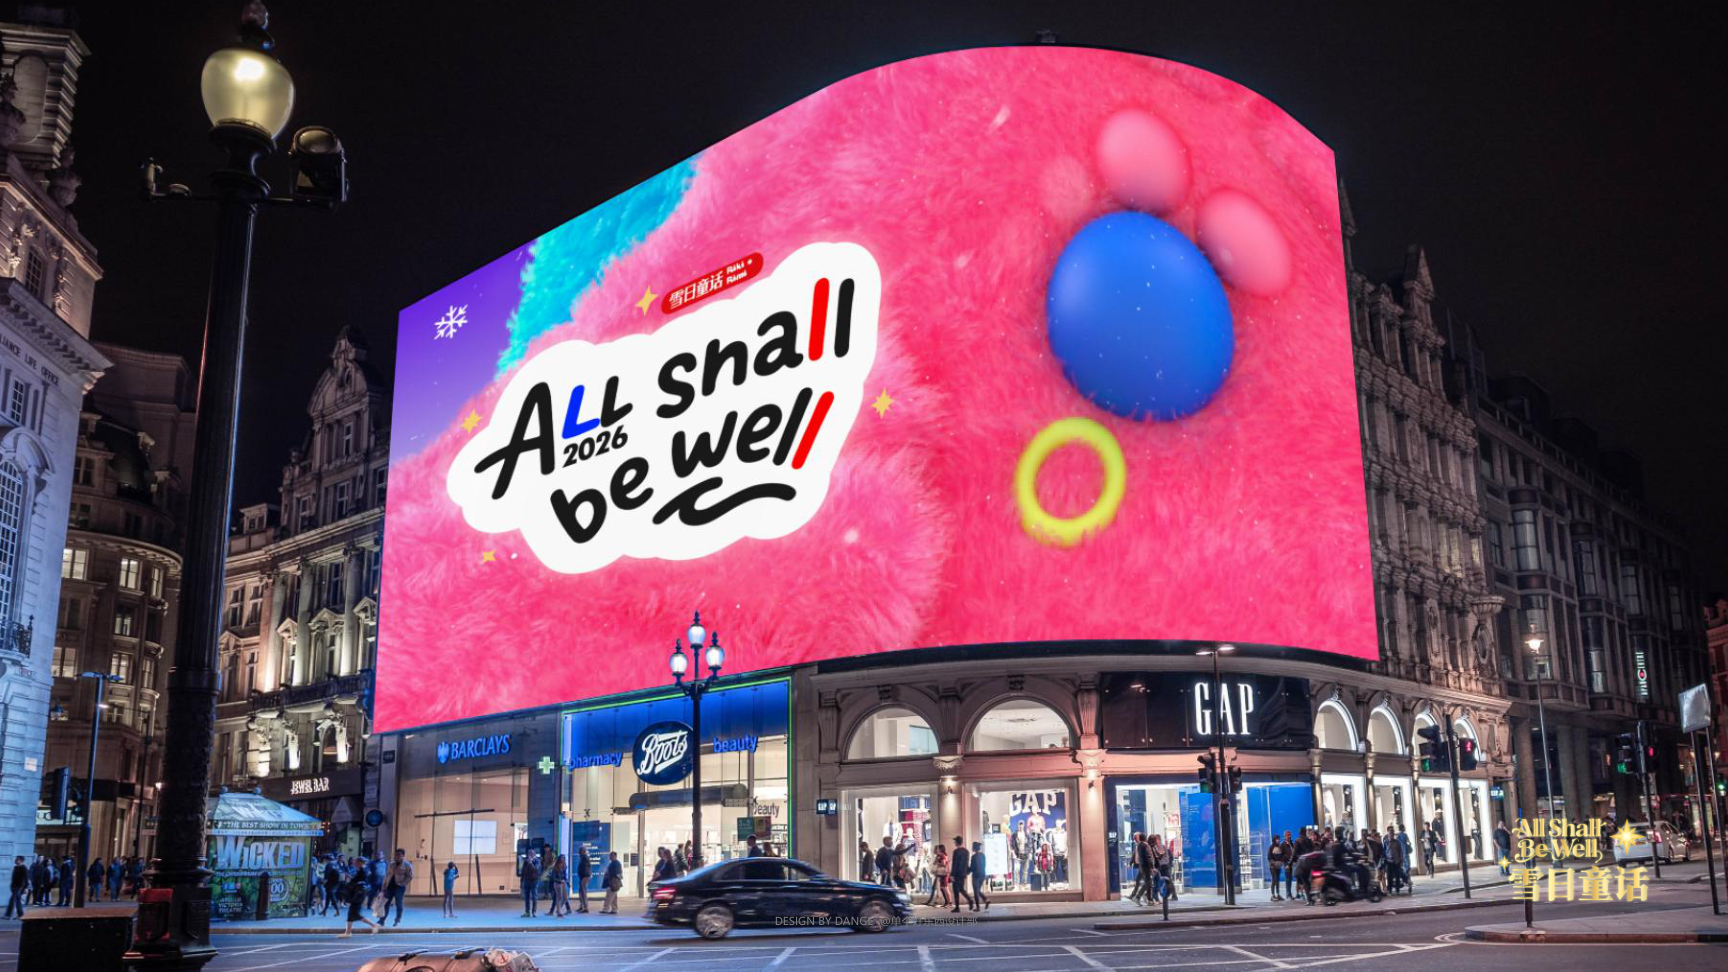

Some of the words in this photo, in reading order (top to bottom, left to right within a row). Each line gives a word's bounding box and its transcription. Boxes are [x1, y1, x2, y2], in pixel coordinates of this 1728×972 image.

[668, 270, 724, 310] 雪日童话
[562, 425, 629, 468] 2026
[550, 457, 654, 544] be
[671, 387, 835, 479] well
[1194, 682, 1254, 736] GAP
[451, 735, 511, 760] BARCLAYS
[637, 730, 689, 775] Boots
[713, 734, 759, 753] beauty
[569, 752, 622, 774] pharmacy
[313, 777, 330, 793] BAR
[1009, 790, 1058, 816] GAP
